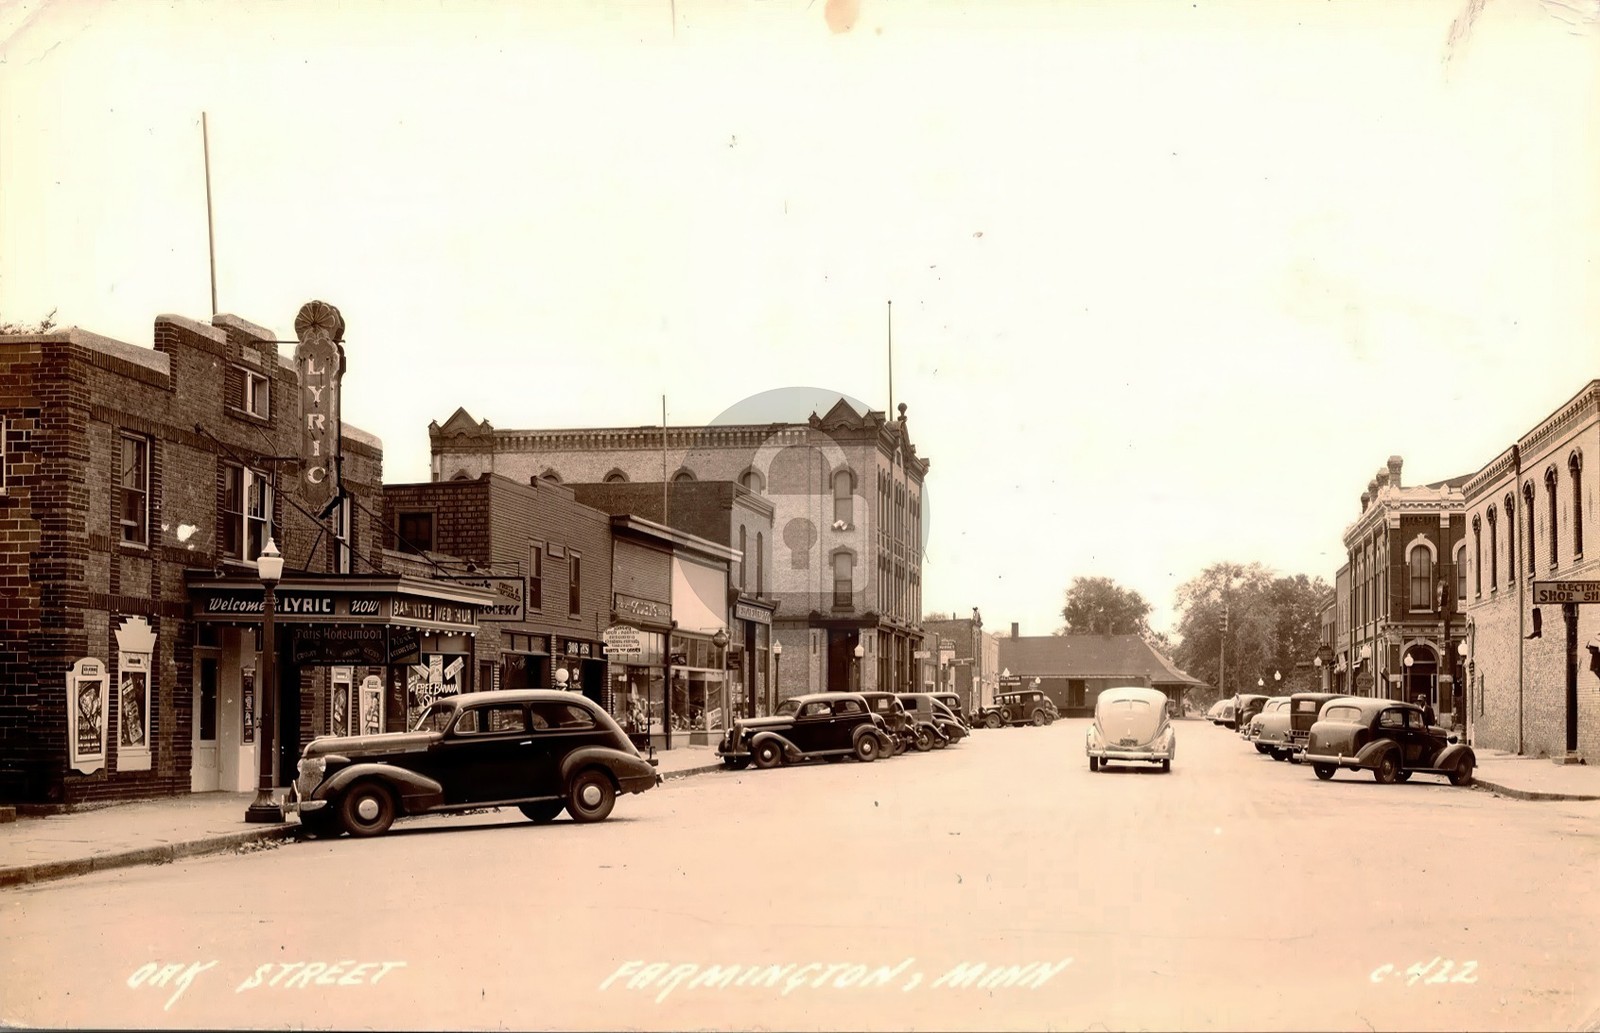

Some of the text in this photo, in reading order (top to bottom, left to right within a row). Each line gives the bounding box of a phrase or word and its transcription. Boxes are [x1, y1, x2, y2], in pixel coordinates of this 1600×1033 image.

[307, 358, 326, 484] LYRIC
[1539, 589, 1574, 601] SHOE
[208, 597, 265, 611] Welcome
[284, 598, 331, 612] LYRIC
[478, 604, 520, 616] ROCERY
[323, 627, 382, 641] Honeymoon
